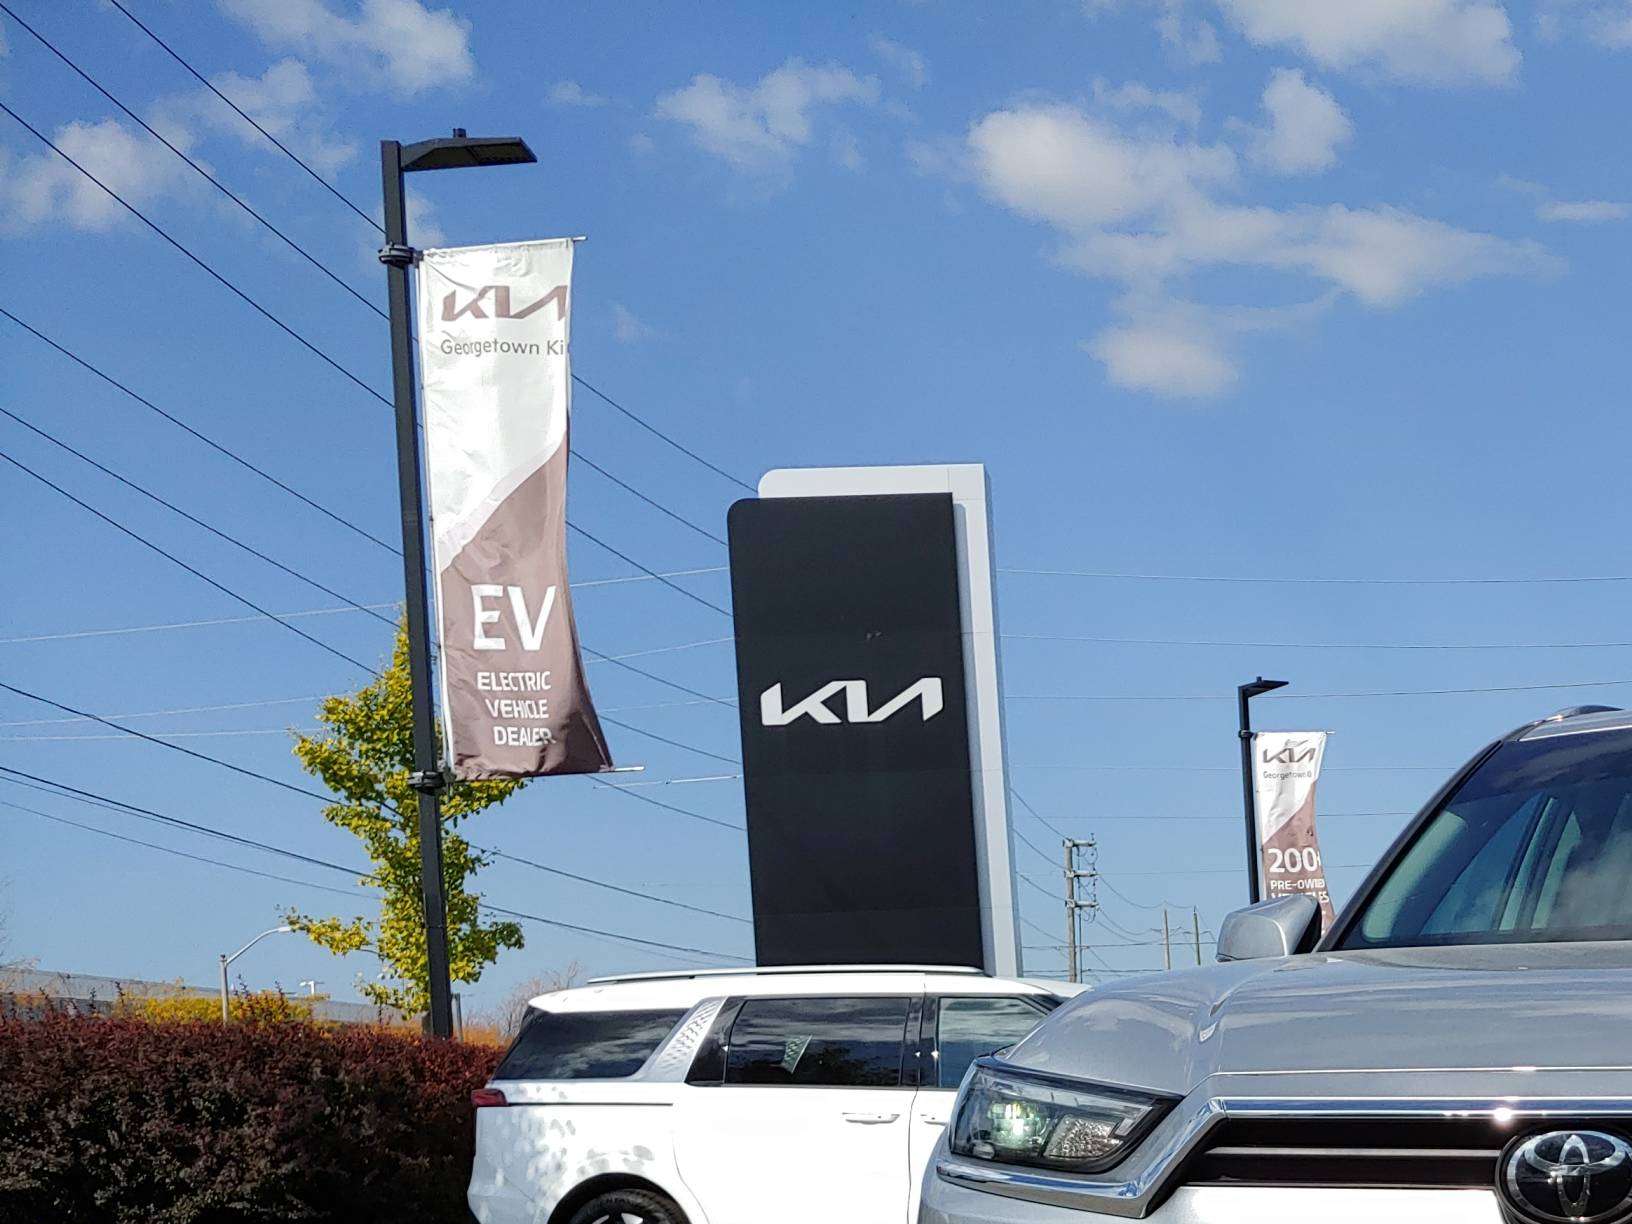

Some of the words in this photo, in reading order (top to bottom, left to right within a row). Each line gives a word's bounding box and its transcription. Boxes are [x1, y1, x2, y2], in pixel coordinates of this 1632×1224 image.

[441, 285, 568, 321] KIA
[440, 338, 540, 357] Georgetown
[546, 339, 569, 355] Ki
[470, 584, 557, 651] EV
[476, 671, 551, 691] ELECTRIC
[484, 698, 550, 719] VEHICLE
[760, 677, 944, 726] KIA
[493, 726, 557, 747] DEALER
